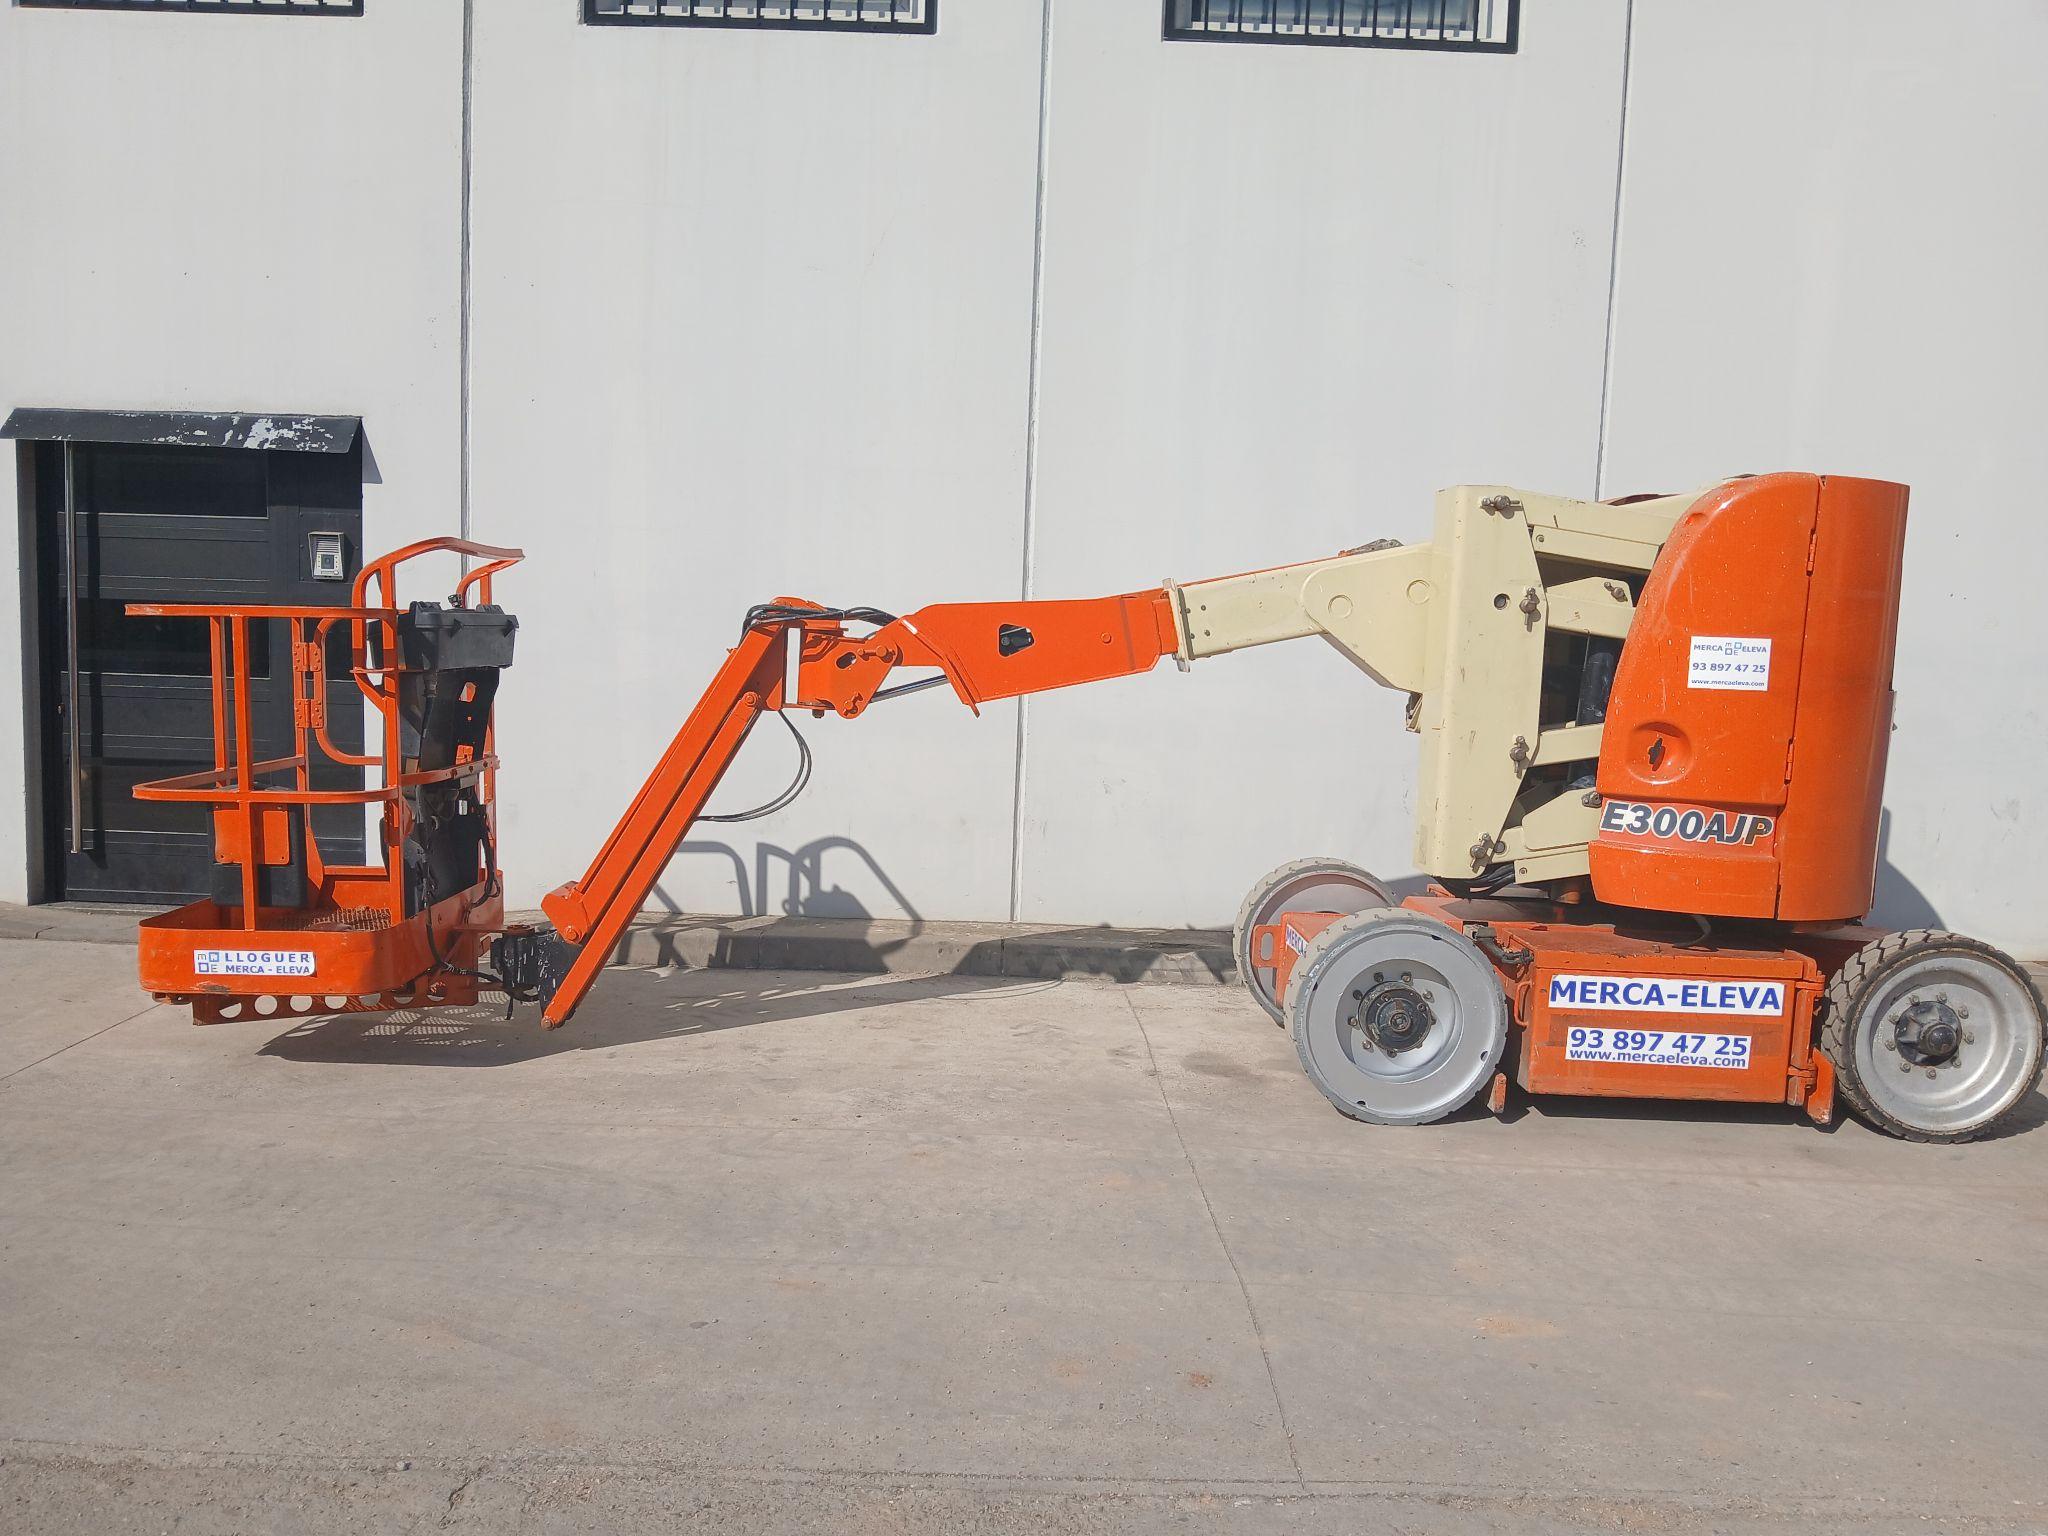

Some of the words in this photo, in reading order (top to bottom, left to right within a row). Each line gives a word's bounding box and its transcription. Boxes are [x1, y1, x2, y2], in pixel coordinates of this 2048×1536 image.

[1693, 644, 1723, 652] MERCA
[1742, 645, 1767, 653] ELEVA
[1692, 662, 1707, 671] 93
[1710, 663, 1732, 672] 897
[1734, 664, 1749, 672] 47
[1752, 664, 1766, 673] 25
[1691, 679, 1765, 687] www.mercaeleva.com
[1600, 800, 1774, 847] E300AJP
[225, 952, 310, 963] LLOGUER
[225, 964, 265, 973] MERCA
[276, 965, 310, 974] ELEVA
[1549, 980, 1781, 1010] MERCA-ELEVA
[1570, 1028, 1604, 1048] 93
[1612, 1030, 1664, 1052] 897
[1671, 1034, 1707, 1053] 47
[1715, 1036, 1748, 1056] 25
[1569, 1048, 1746, 1068] www.mercaeleva.com
